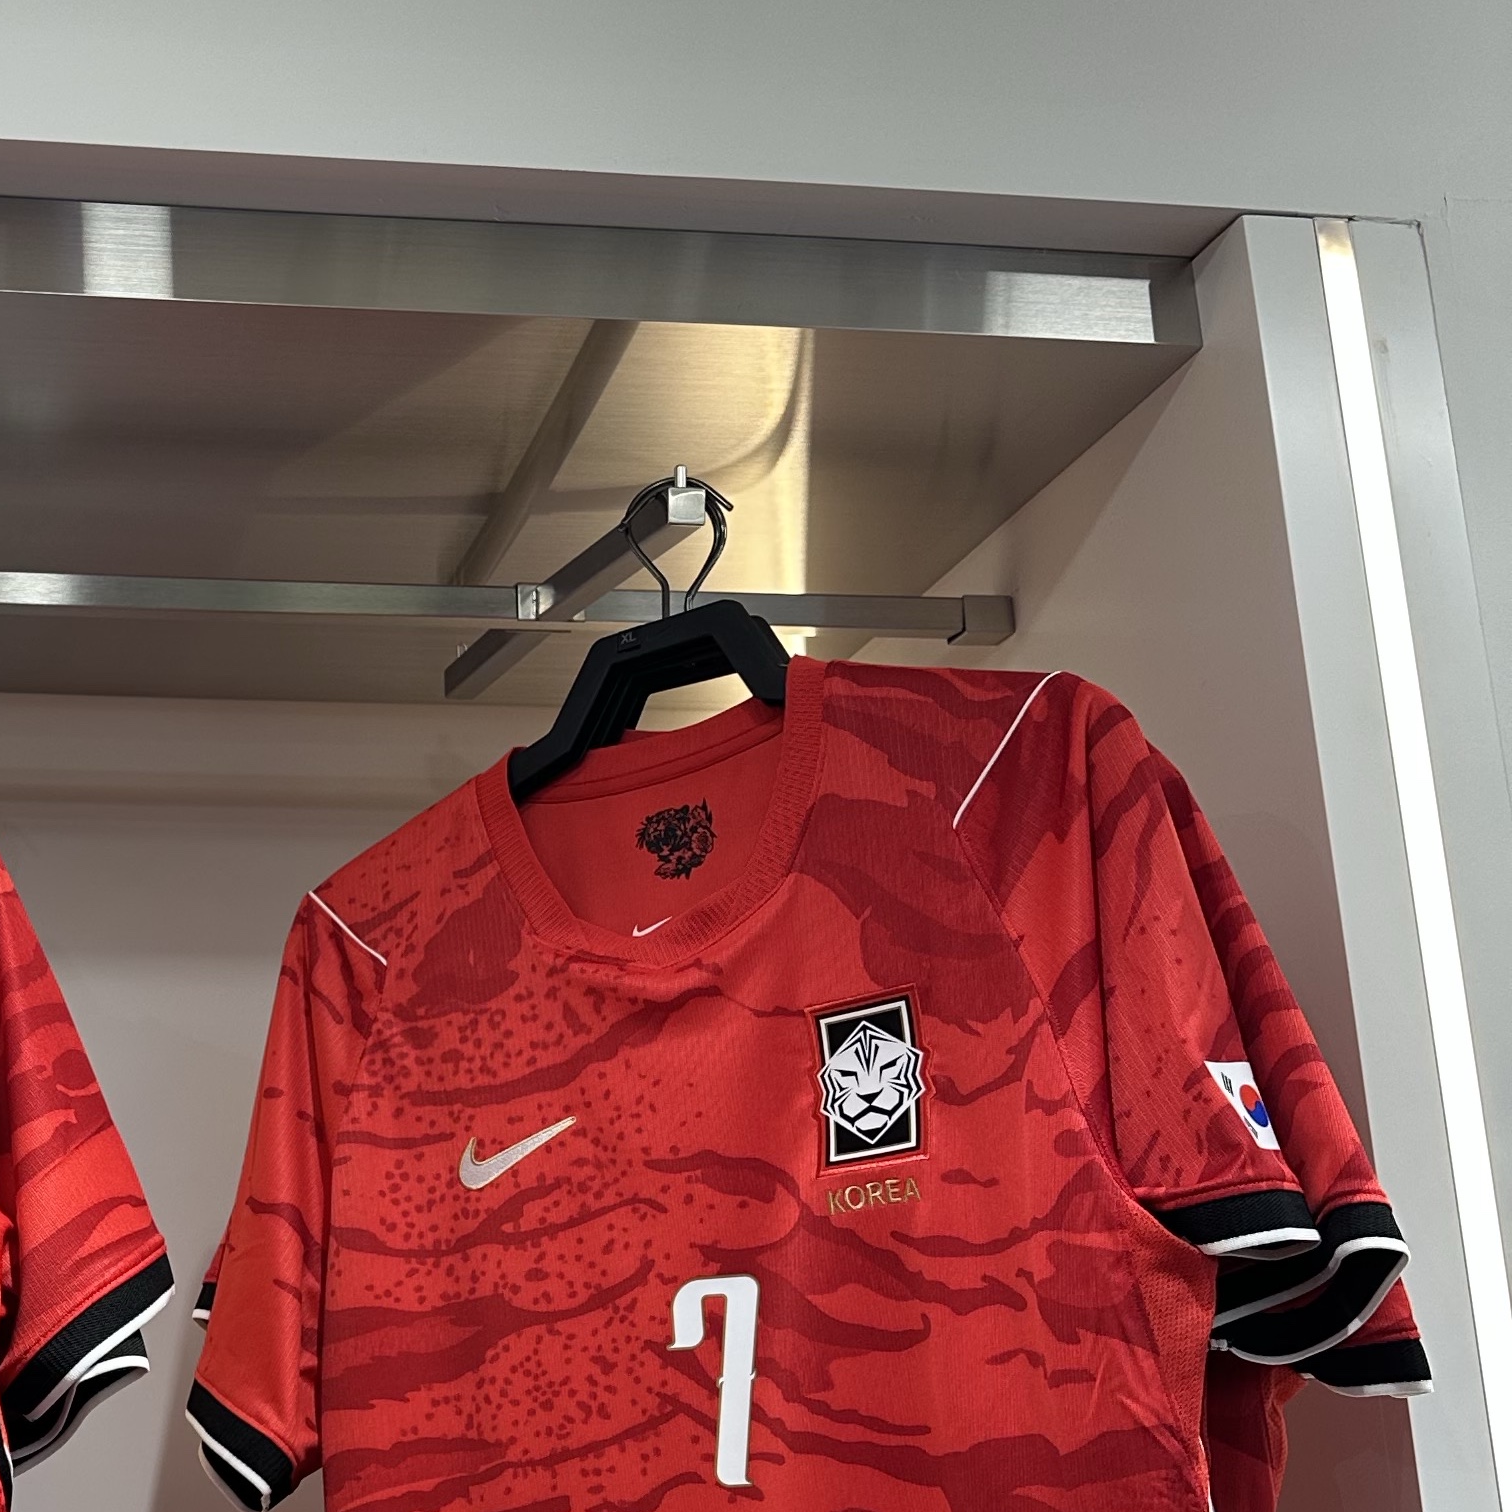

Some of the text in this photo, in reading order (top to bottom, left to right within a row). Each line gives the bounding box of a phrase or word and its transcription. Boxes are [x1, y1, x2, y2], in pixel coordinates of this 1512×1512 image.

[620, 632, 637, 645] XL
[827, 1177, 921, 1215] KOREA
[666, 1273, 760, 1487] 7
